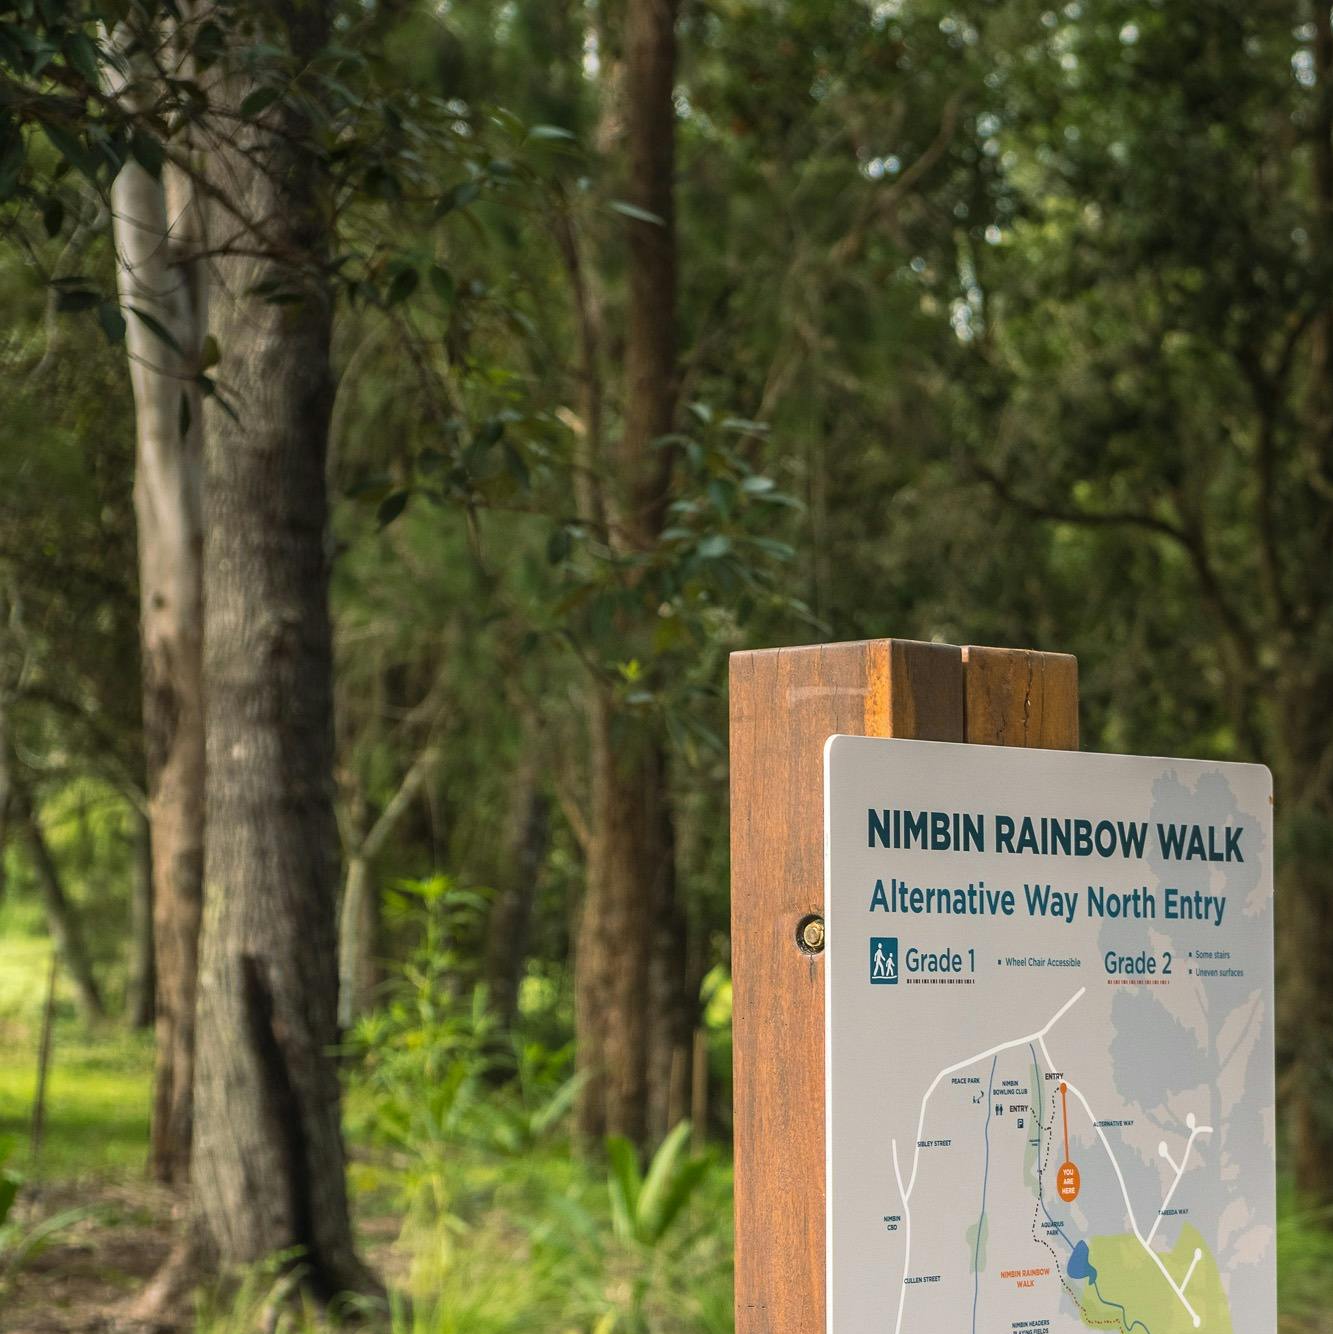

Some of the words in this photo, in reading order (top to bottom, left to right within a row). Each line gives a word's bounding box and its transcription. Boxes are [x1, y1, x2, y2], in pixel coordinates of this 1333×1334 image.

[867, 808, 985, 853] NIMBIN
[994, 814, 1148, 860] RAINBOW
[1157, 823, 1245, 863] WALK
[869, 879, 1015, 916] Alternative
[1024, 884, 1078, 924] Way
[1087, 887, 1156, 919] North
[1165, 888, 1226, 926] Entry
[1195, 950, 1213, 959] Some
[1214, 951, 1231, 959] stairs
[906, 948, 962, 973] Grade
[968, 949, 975, 972] 1
[1005, 957, 1027, 967] Wheel
[1028, 957, 1046, 967] Chair
[1047, 957, 1081, 968] Accessible
[1104, 951, 1157, 975] Grade
[1162, 951, 1172, 974] 2
[1195, 968, 1218, 977] Uneven
[1219, 968, 1244, 977] surfaces
[1000, 1270, 1021, 1279] NIMBIN
[1022, 1268, 1050, 1277] RAINBOW
[904, 1276, 922, 1284] CULLEN
[923, 1275, 941, 1283] STREET
[1016, 1280, 1034, 1288] WALK
